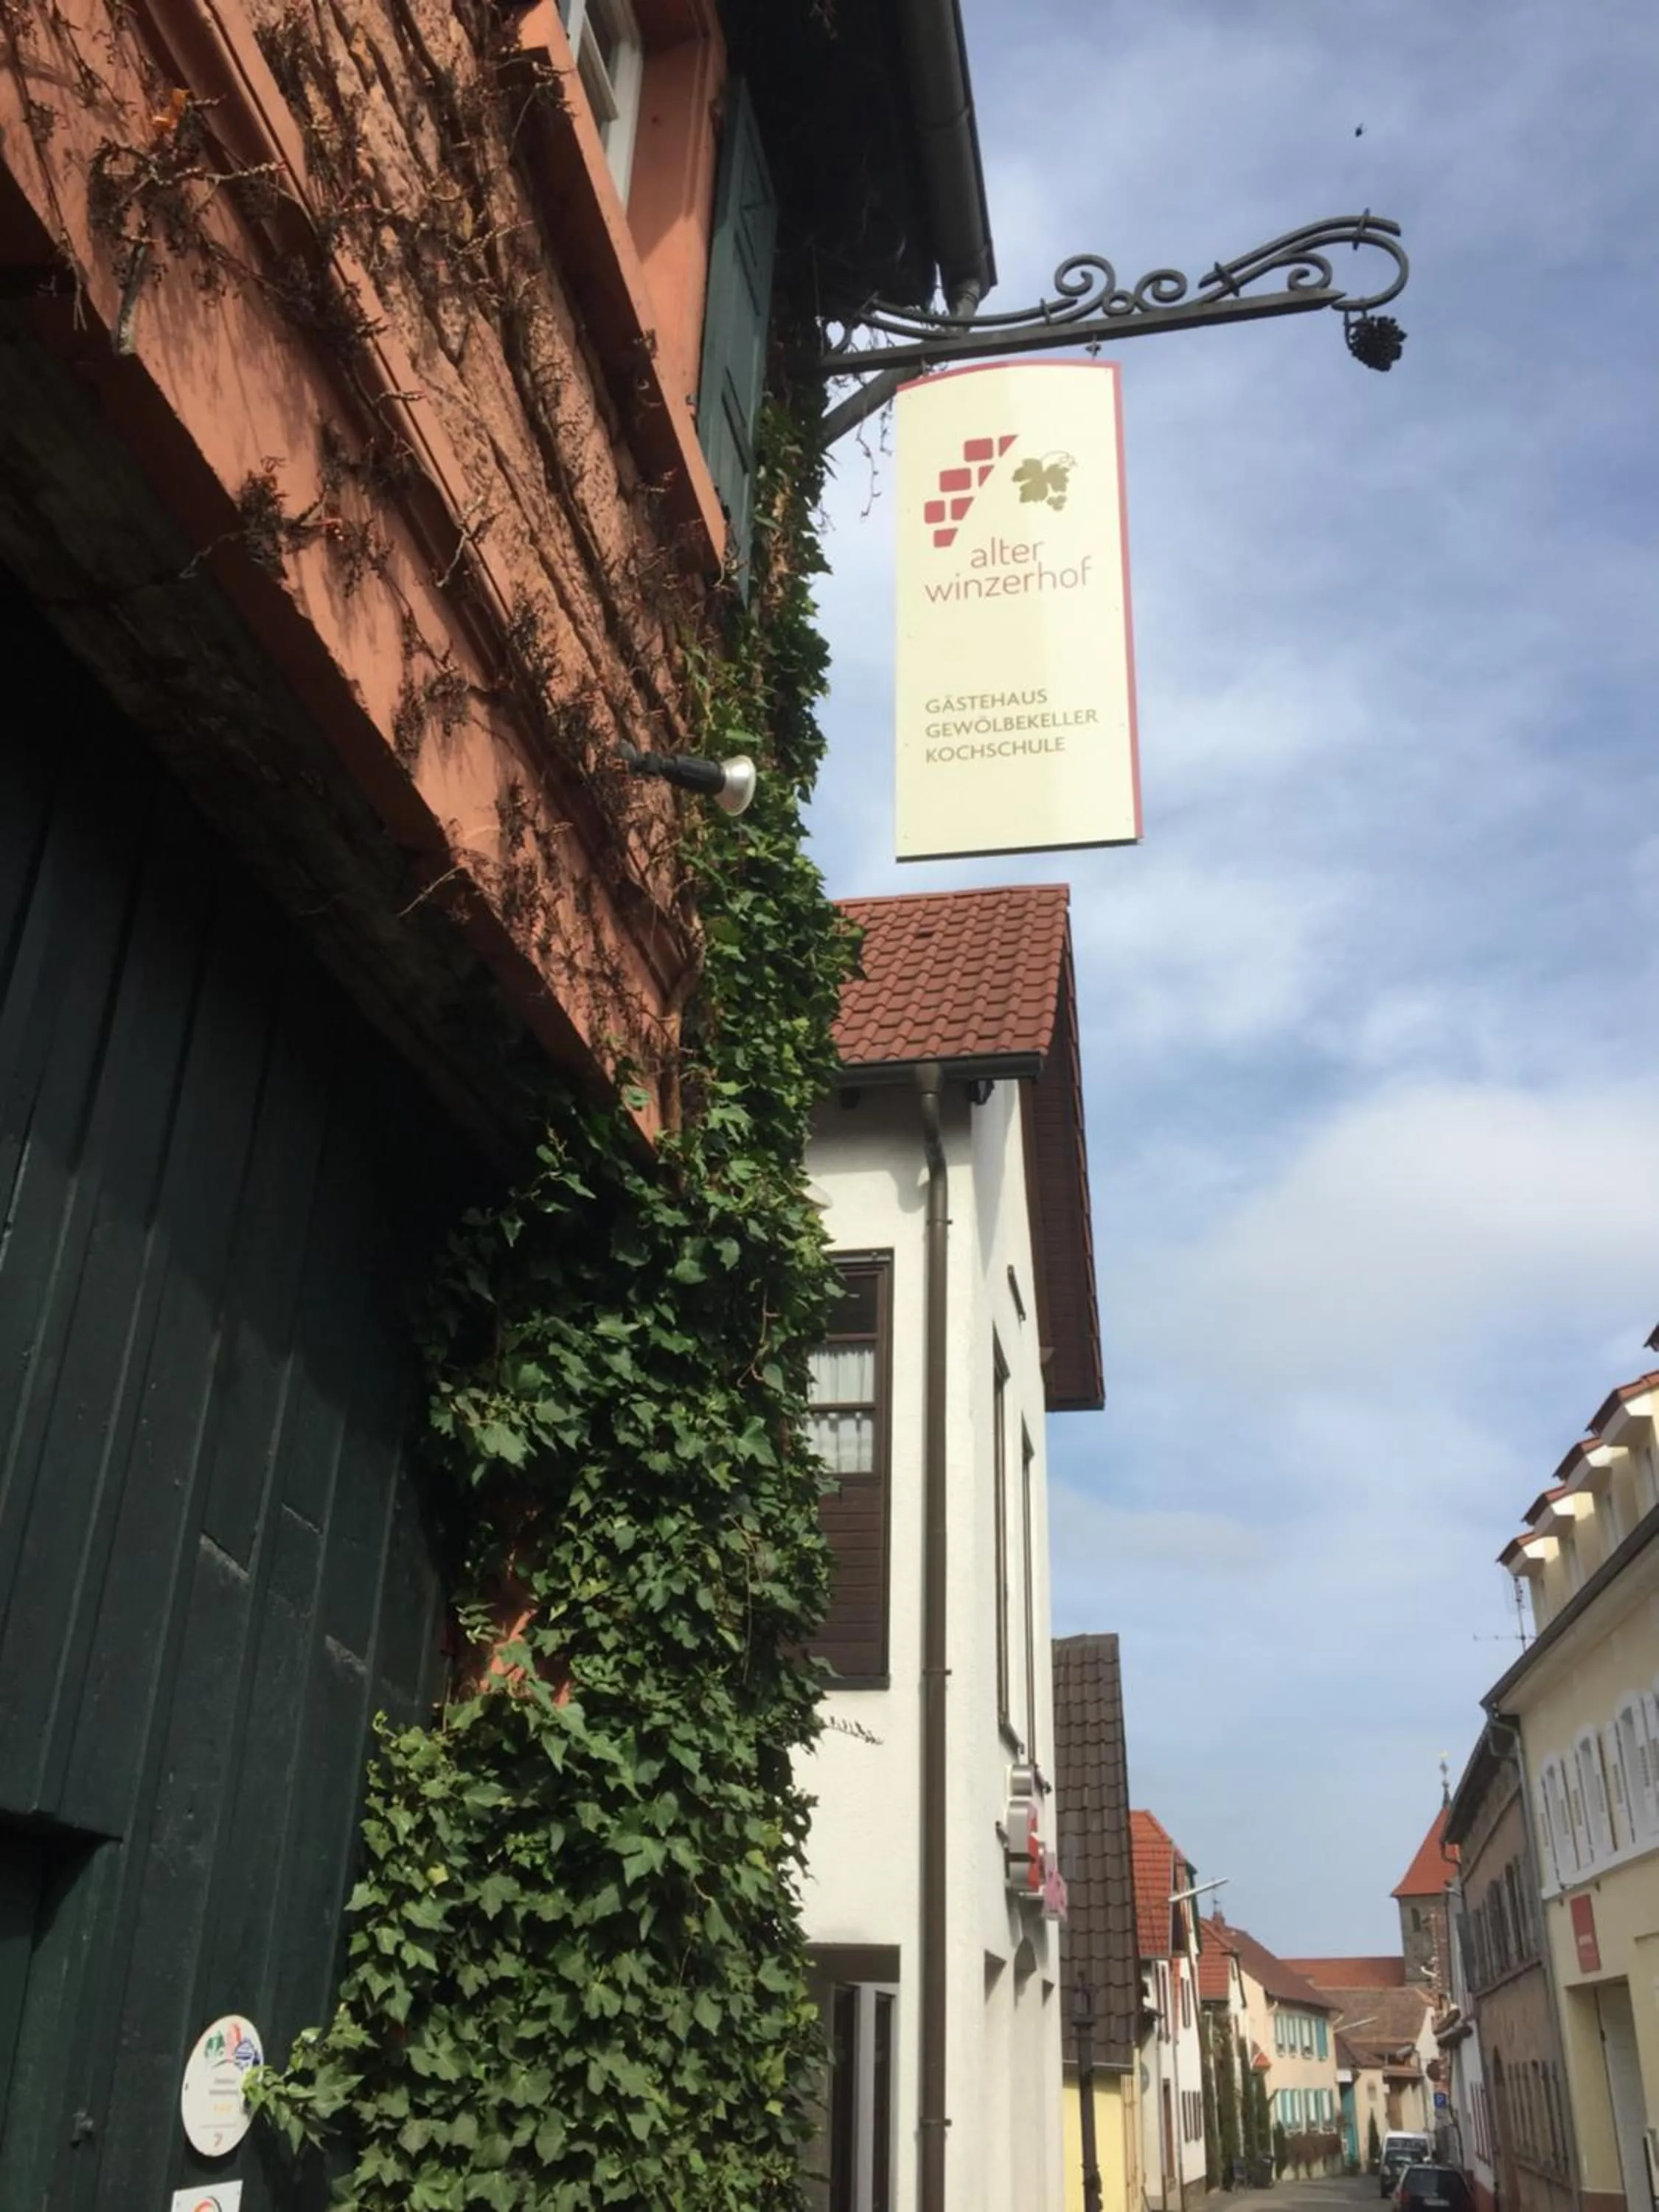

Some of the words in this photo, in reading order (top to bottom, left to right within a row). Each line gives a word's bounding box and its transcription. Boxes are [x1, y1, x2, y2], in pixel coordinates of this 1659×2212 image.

[970, 536, 1045, 568] alter
[925, 554, 1093, 602] winzerhof
[925, 688, 1048, 714] GÄSTEHAUS
[925, 709, 1099, 738] GEWÖLBEKELLER
[925, 737, 1065, 763] KOCHSCHULE
